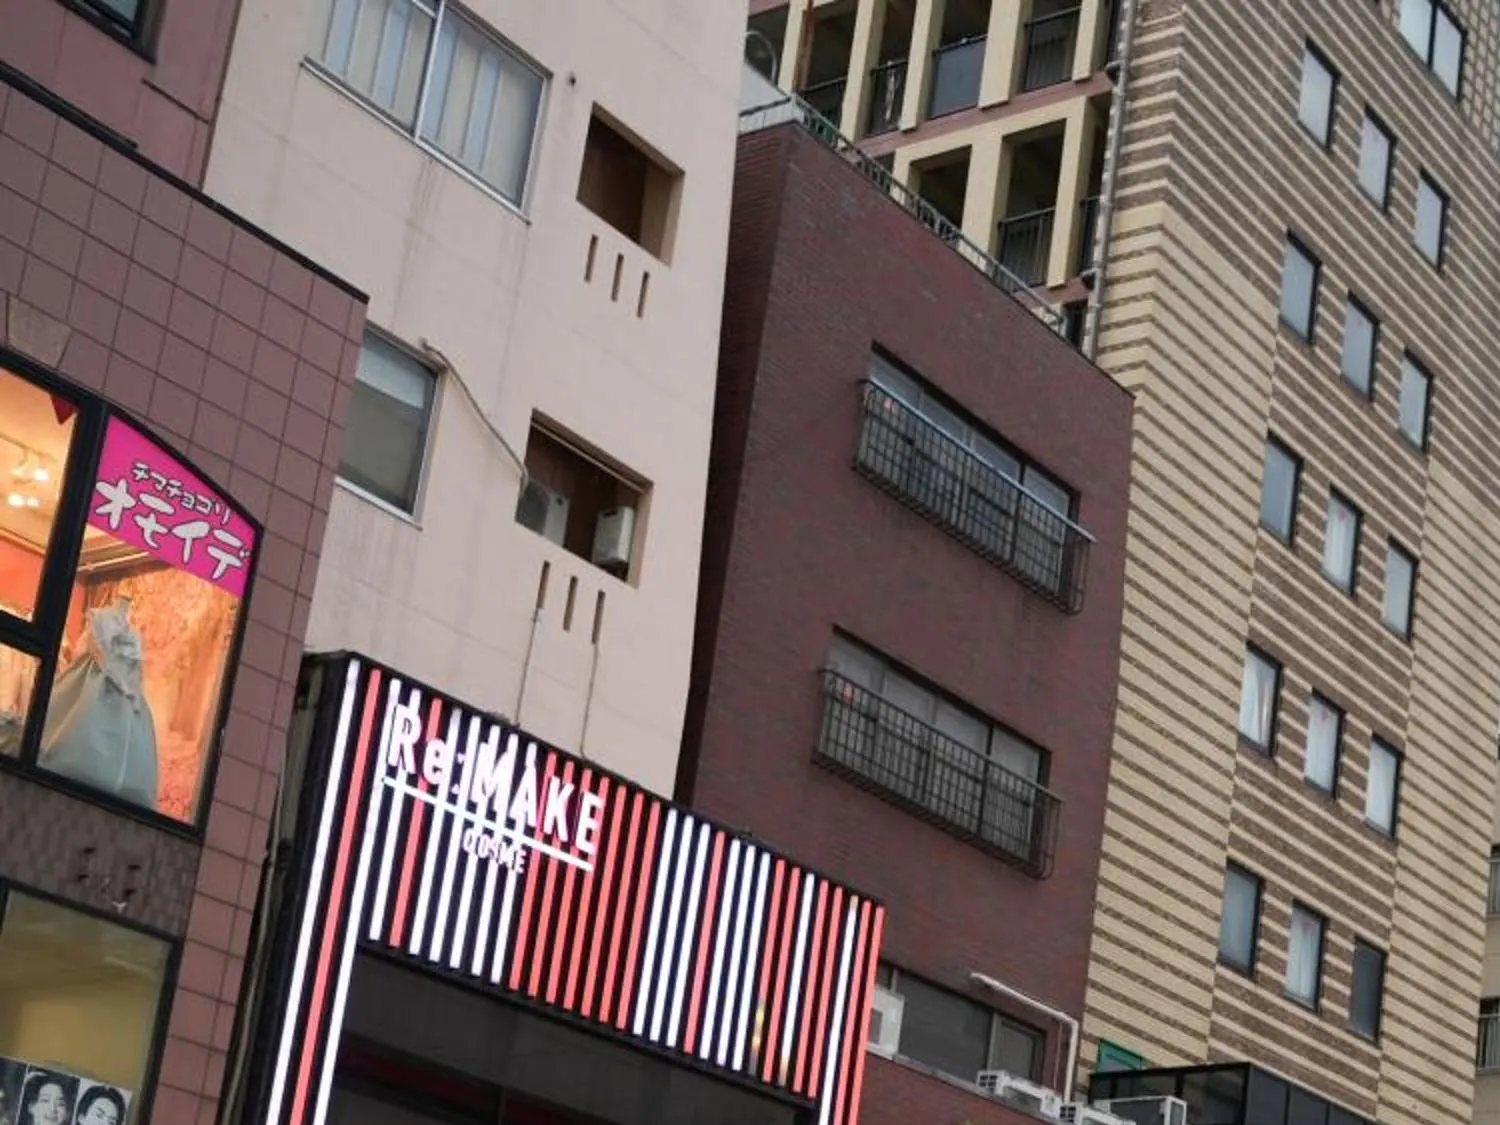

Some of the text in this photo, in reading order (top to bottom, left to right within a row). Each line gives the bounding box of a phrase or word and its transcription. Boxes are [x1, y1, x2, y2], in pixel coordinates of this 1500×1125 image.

[132, 461, 232, 526] チマチョゴリ
[387, 702, 605, 857] Re:MAKE
